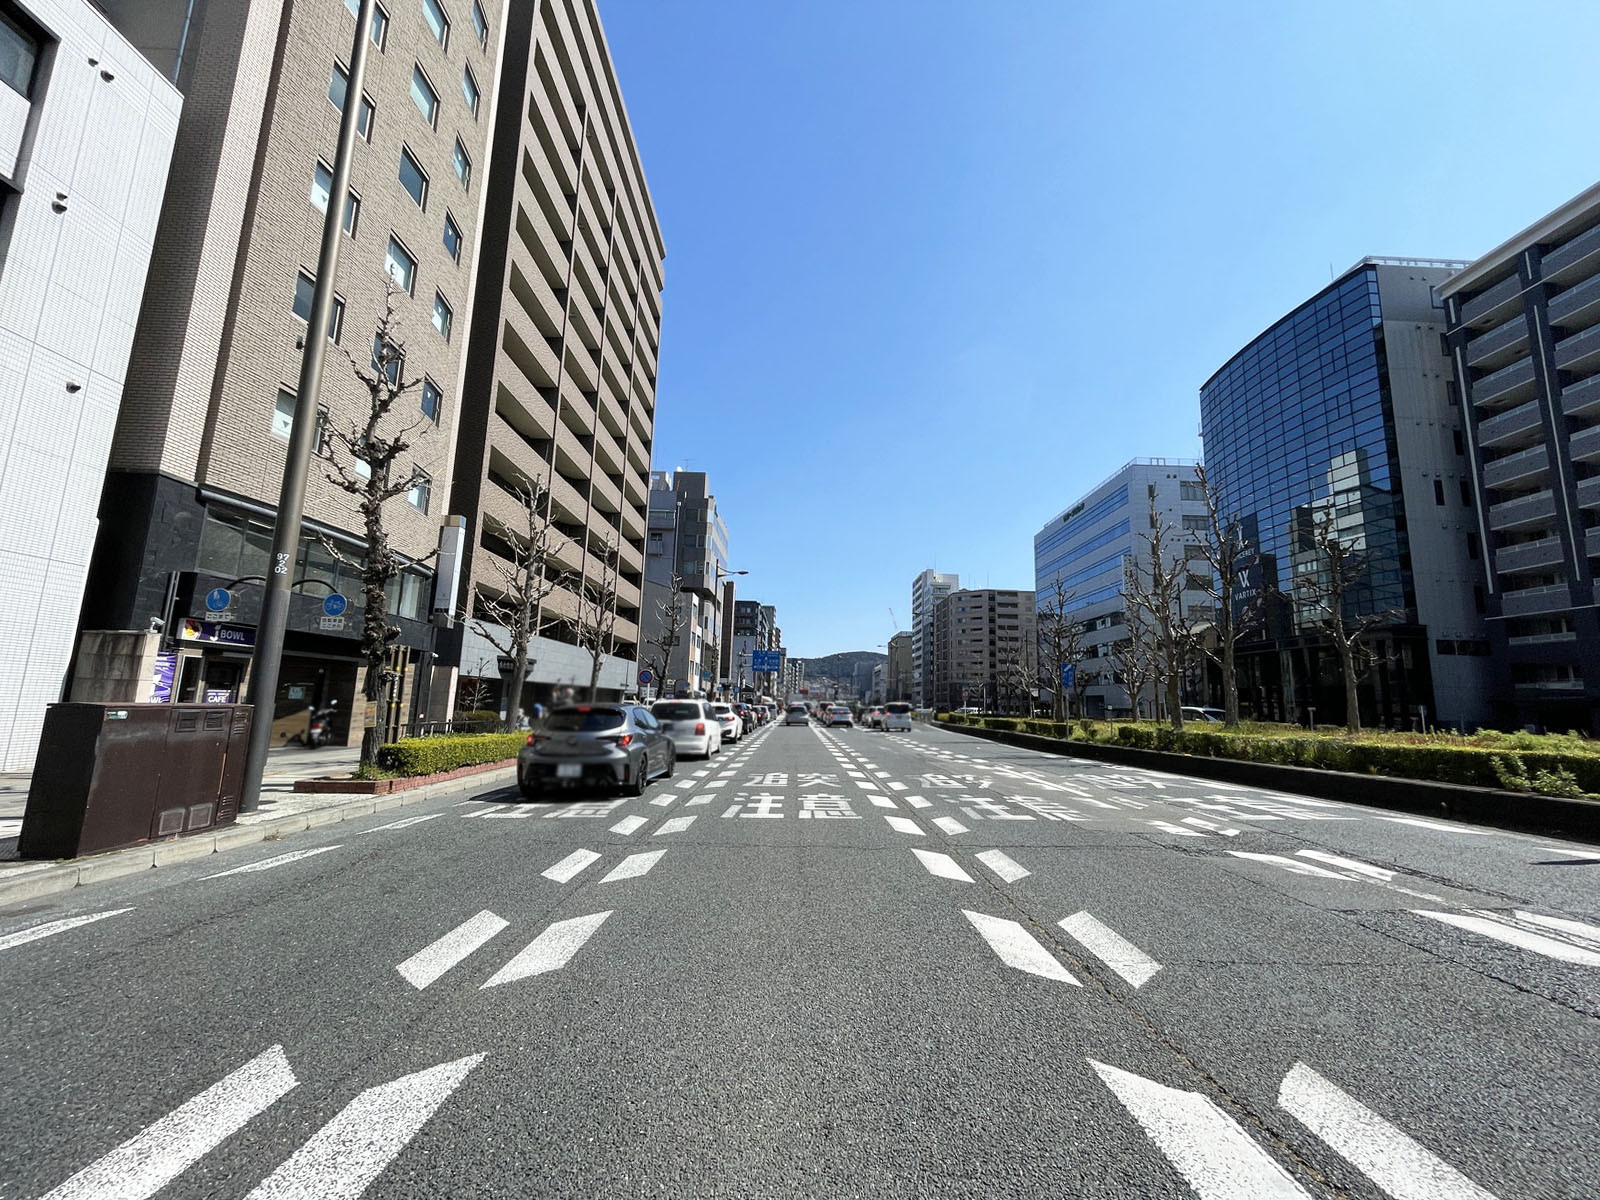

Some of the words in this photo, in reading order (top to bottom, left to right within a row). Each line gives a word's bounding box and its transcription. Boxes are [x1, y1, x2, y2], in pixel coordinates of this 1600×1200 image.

[276, 552, 290, 561] 97
[274, 566, 288, 574] 02
[220, 629, 245, 641] BOWL
[742, 772, 841, 788] 追突
[720, 792, 862, 819] 注意
